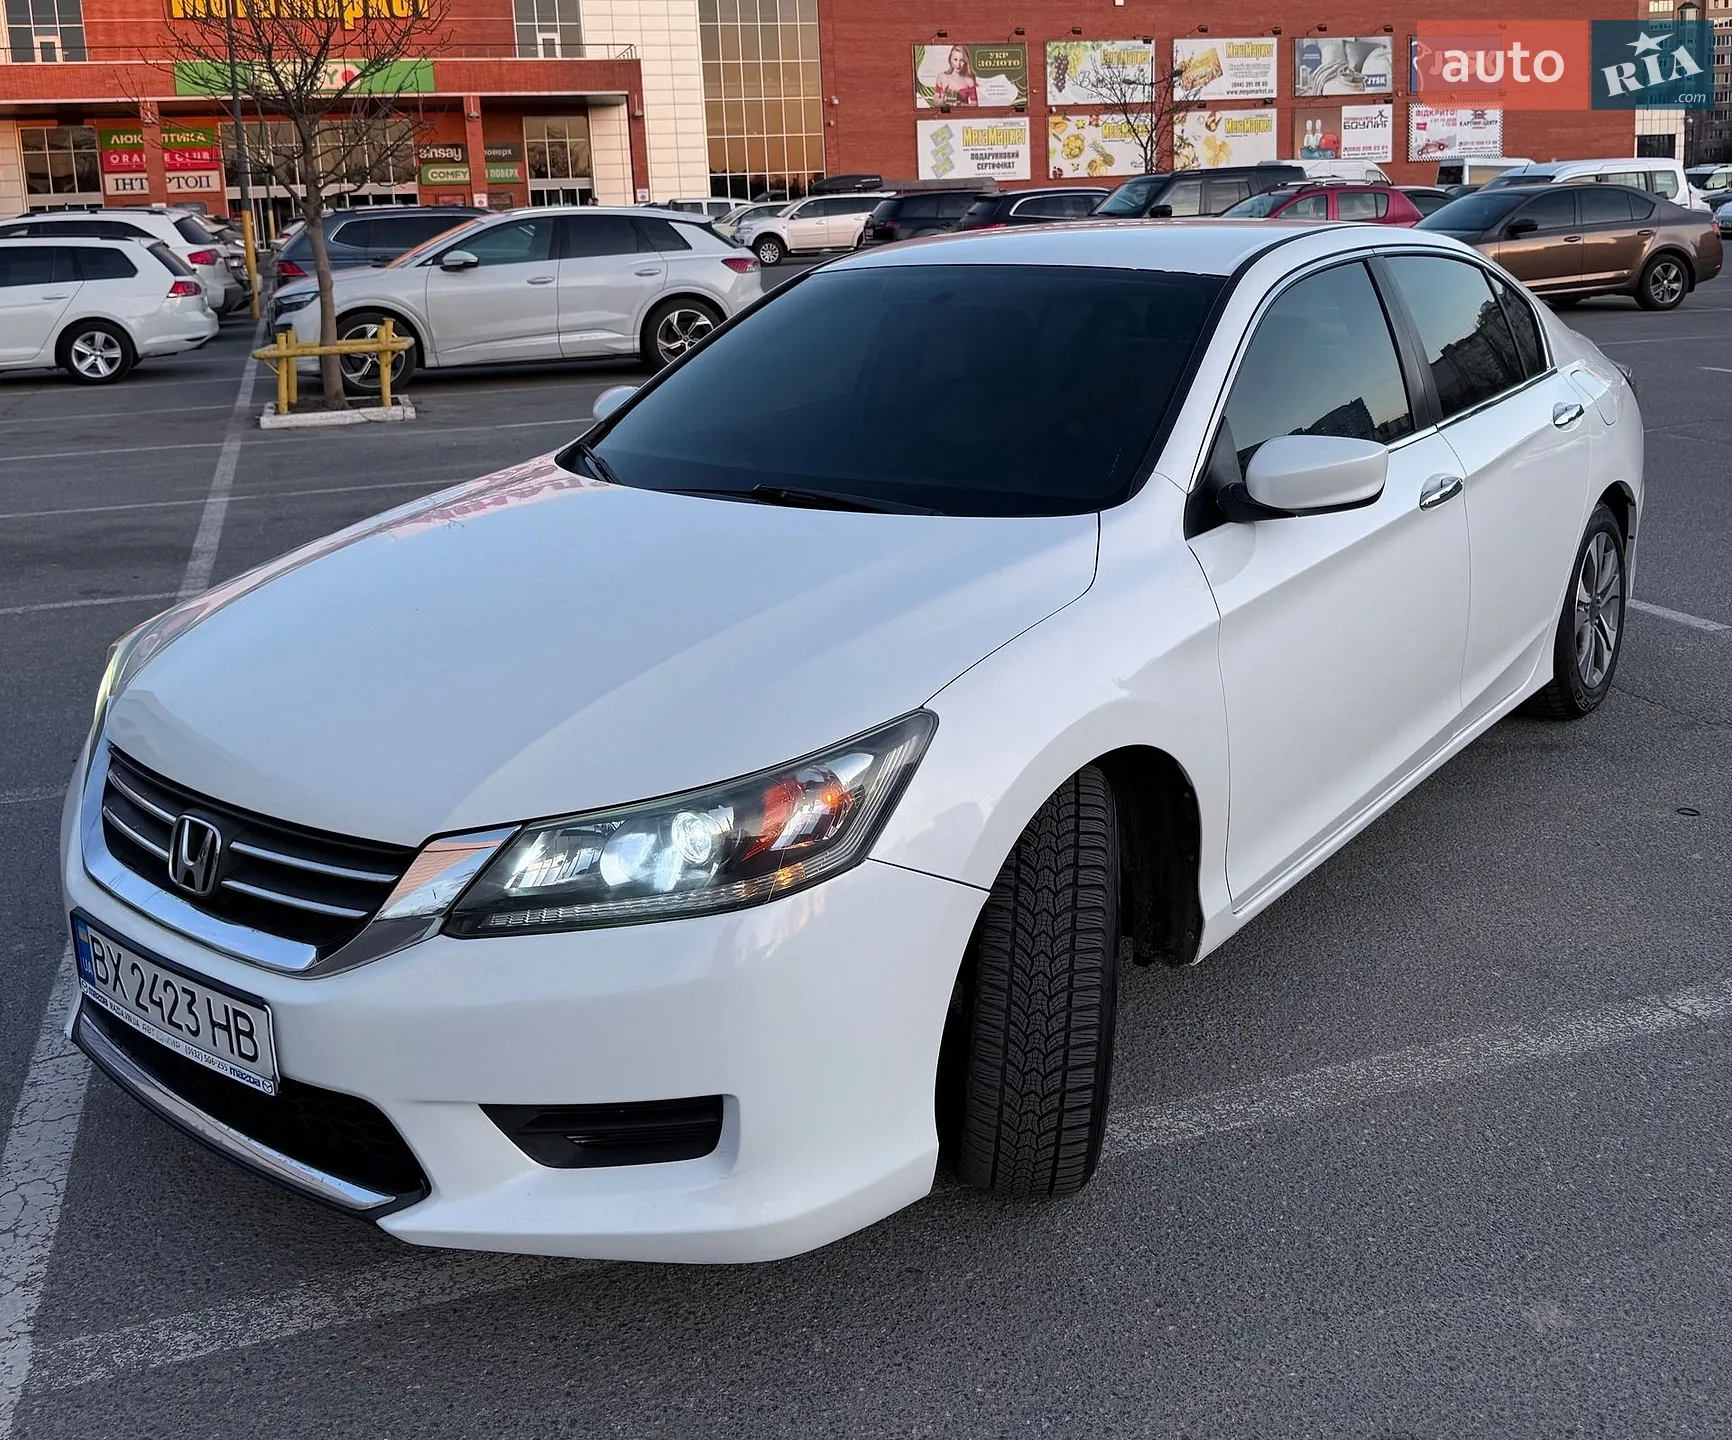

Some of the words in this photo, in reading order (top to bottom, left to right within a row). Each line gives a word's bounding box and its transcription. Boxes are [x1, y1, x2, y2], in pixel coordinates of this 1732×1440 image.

[989, 52, 1009, 60] УКР
[1366, 76, 1386, 85] JYSK
[962, 125, 1026, 149] МегаМаркет
[420, 146, 462, 161] sinsay
[970, 150, 1020, 161] ПОДАРУНКОВИЙ
[976, 161, 1015, 171] СЕРТИФІКАТ
[430, 168, 468, 180] COMFY
[90, 934, 129, 1001] BX
[130, 961, 201, 1038] 2423
[206, 996, 259, 1063] HB
[229, 1066, 262, 1088] mazda
